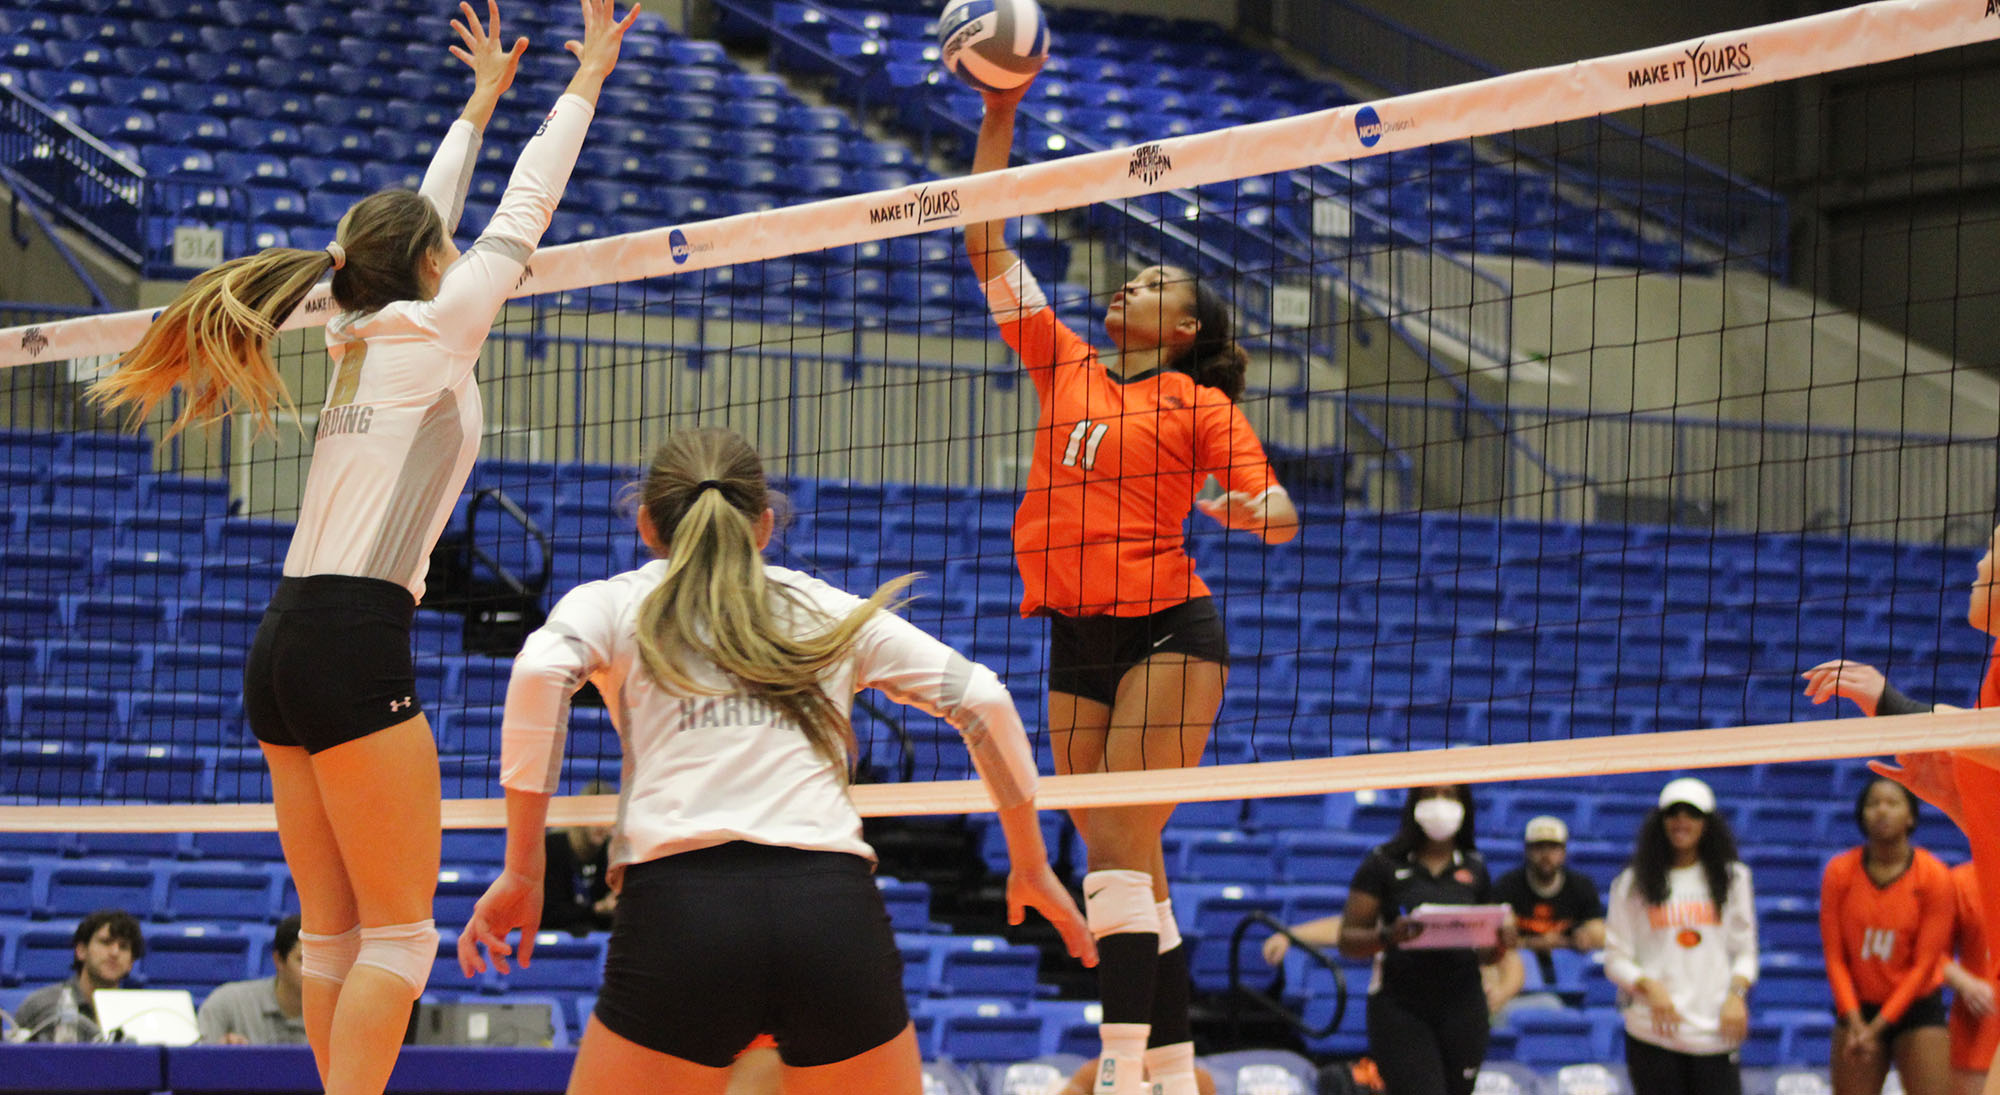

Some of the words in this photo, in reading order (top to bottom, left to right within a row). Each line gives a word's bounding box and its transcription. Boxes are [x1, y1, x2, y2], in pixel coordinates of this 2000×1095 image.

[1628, 64, 1670, 88] MAKE
[1673, 60, 1686, 80] IT
[1685, 40, 1752, 88] YOURS
[1359, 123, 1382, 138] NCAA
[870, 205, 902, 225] MAKE
[904, 202, 915, 219] IT
[914, 186, 960, 227] YOURS
[183, 235, 217, 258] 314
[305, 296, 327, 313] MAKE
[1061, 419, 1109, 471] 11
[1861, 927, 1896, 962] 14
